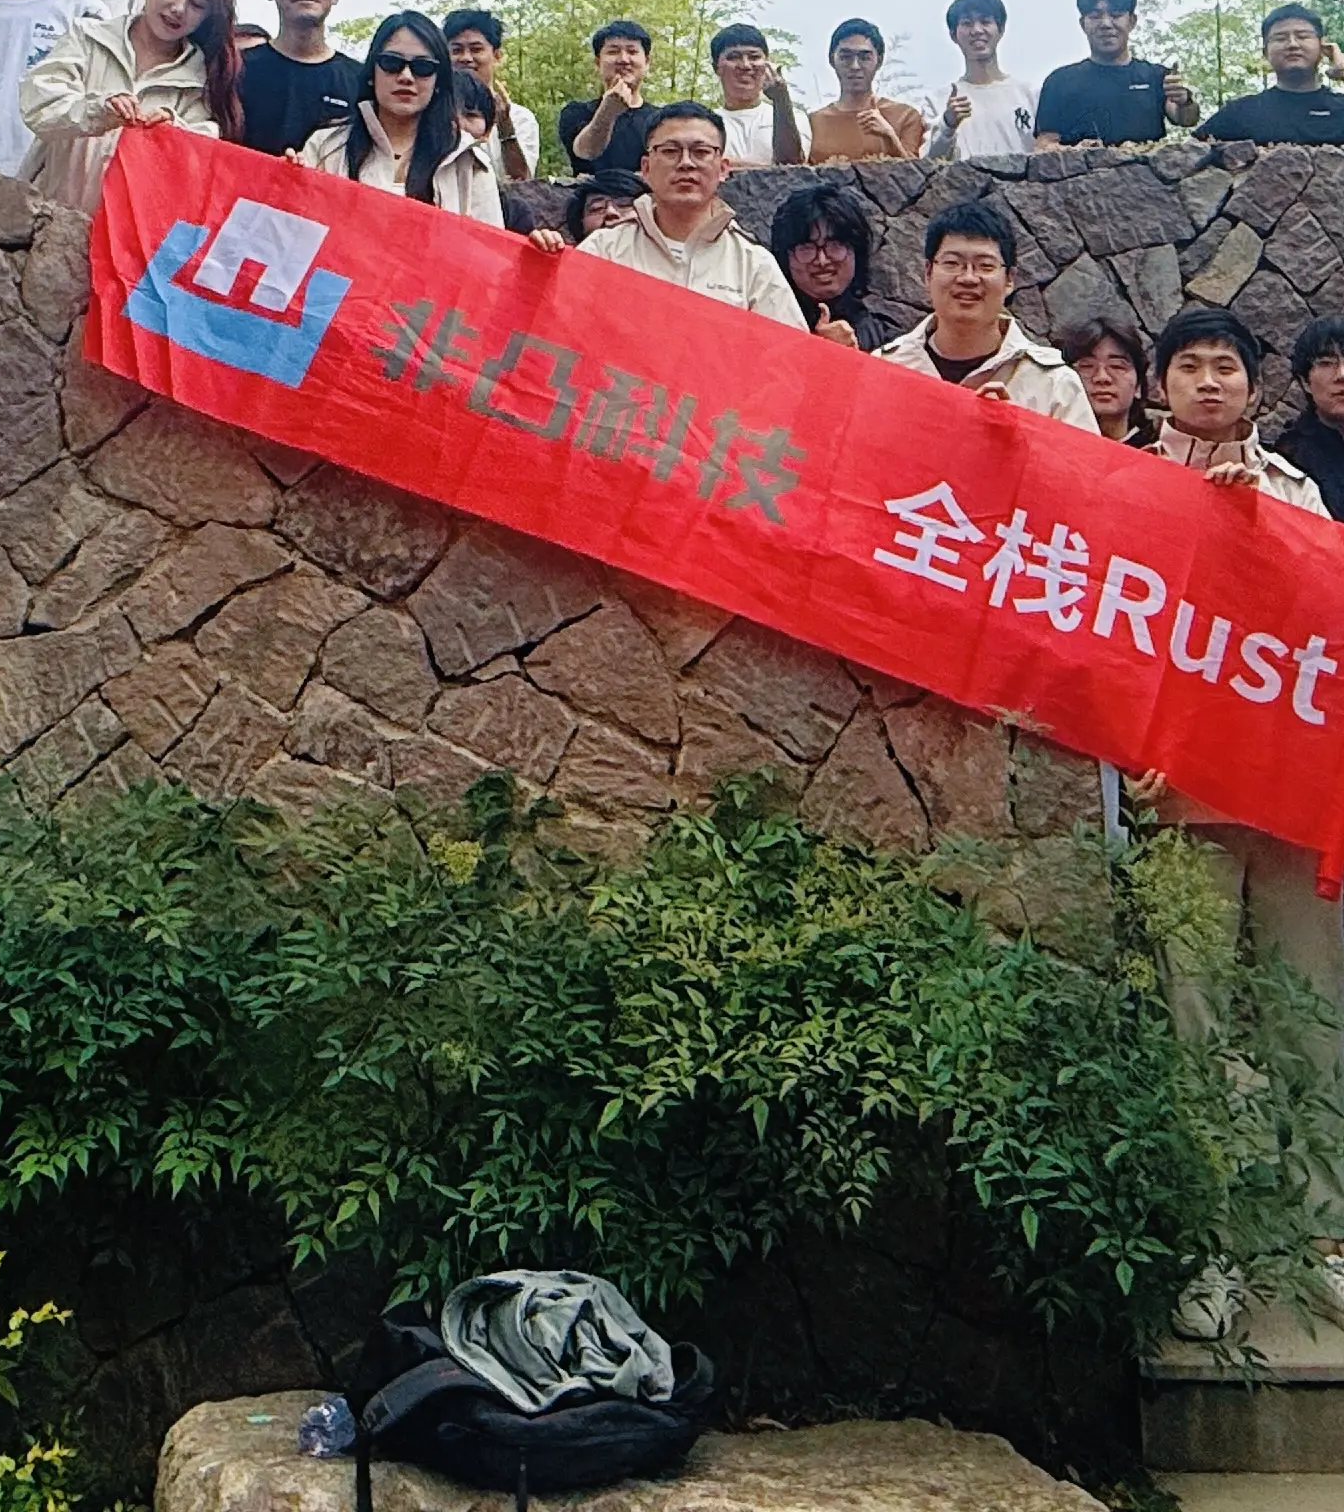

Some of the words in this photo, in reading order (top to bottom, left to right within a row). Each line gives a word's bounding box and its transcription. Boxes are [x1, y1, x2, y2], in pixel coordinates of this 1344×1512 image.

[374, 299, 807, 524] 非凸科技
[872, 481, 1338, 726] 全栈Rust
